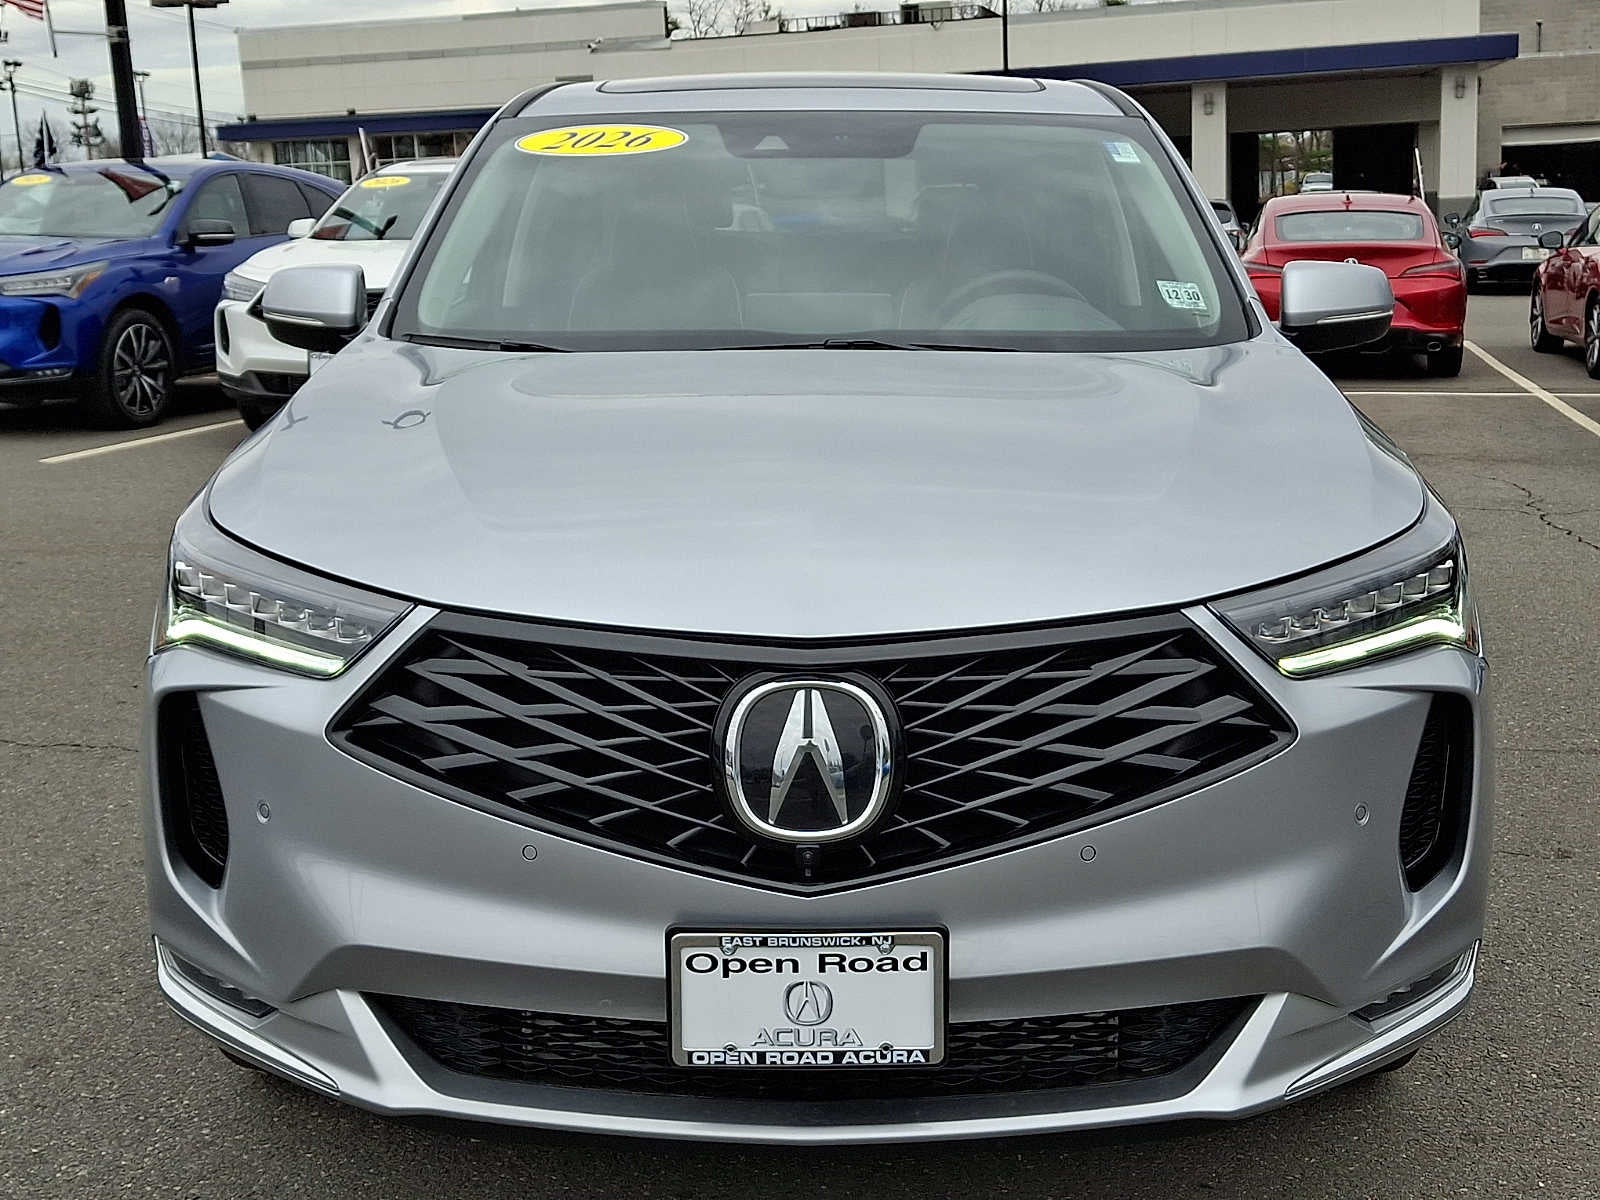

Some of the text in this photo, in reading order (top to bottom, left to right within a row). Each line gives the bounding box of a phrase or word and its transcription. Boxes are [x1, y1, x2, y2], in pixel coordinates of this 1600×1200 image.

[541, 130, 661, 150] 2026
[1166, 289, 1200, 301] 12 30
[721, 936, 762, 947] EAST
[871, 935, 892, 946] NJ
[685, 952, 928, 978] Open Road
[751, 1028, 863, 1047] ACURA
[692, 1050, 926, 1065] OPEN ROAD ACURA
